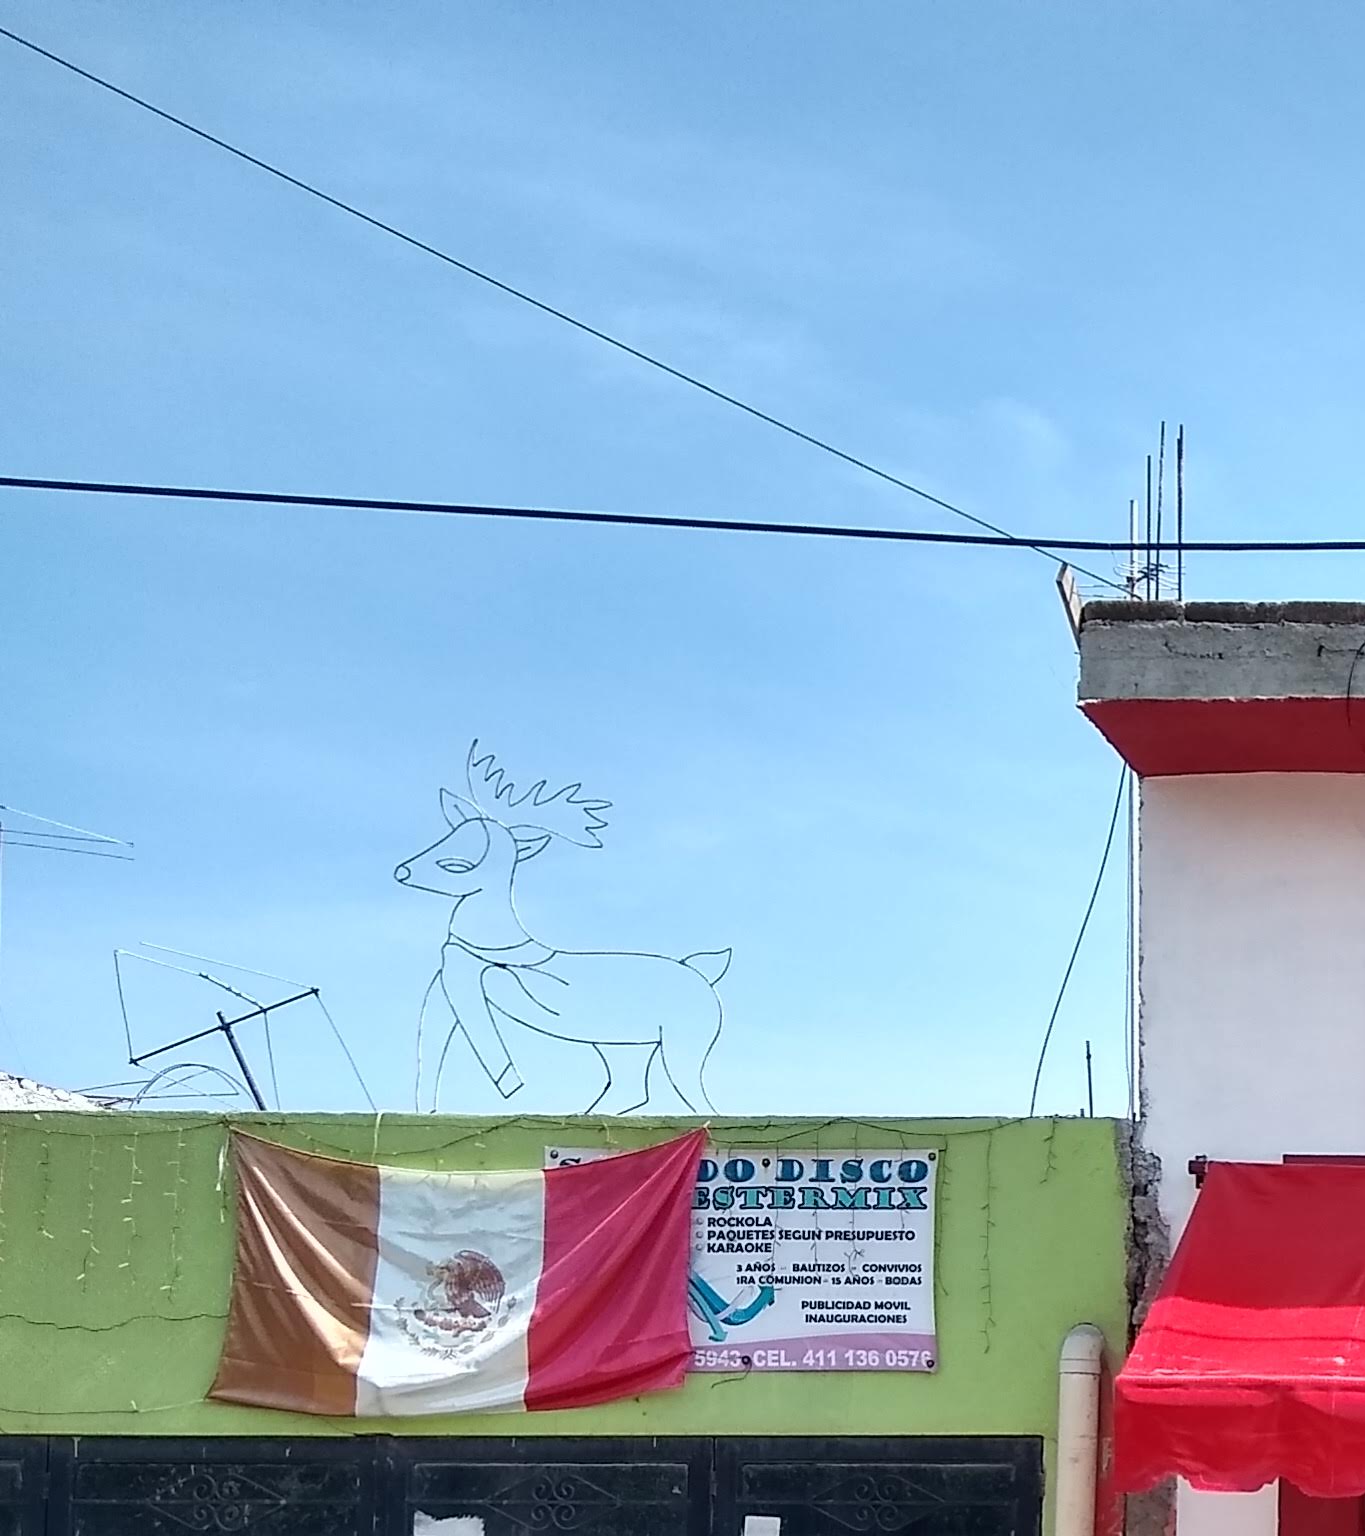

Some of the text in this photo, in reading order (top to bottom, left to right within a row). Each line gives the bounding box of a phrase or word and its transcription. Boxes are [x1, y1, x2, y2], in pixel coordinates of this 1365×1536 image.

[695, 1158, 929, 1184] DO DISCO
[691, 1185, 928, 1211] ESTERMIX
[707, 1217, 773, 1228] ROCKOLA
[707, 1230, 916, 1242] PAQUETES SEGUN PRESUPUESTO
[707, 1242, 773, 1253] KARAOKE
[744, 1261, 776, 1273] AÑOS
[792, 1263, 846, 1273] BAUTIZOS
[862, 1263, 922, 1273] CONVIVIOS
[758, 1275, 822, 1285] COMUNION
[831, 1275, 841, 1285] 15
[843, 1273, 875, 1285] AÑOS
[885, 1276, 922, 1286] BODAS
[801, 1300, 911, 1310] PUBLICIDAD MOVIL
[805, 1314, 908, 1324] INAUGURACIONES
[752, 1349, 798, 1368] CEL.
[803, 1349, 836, 1366] 411
[844, 1349, 880, 1366] 136
[885, 1349, 932, 1367] 0576
